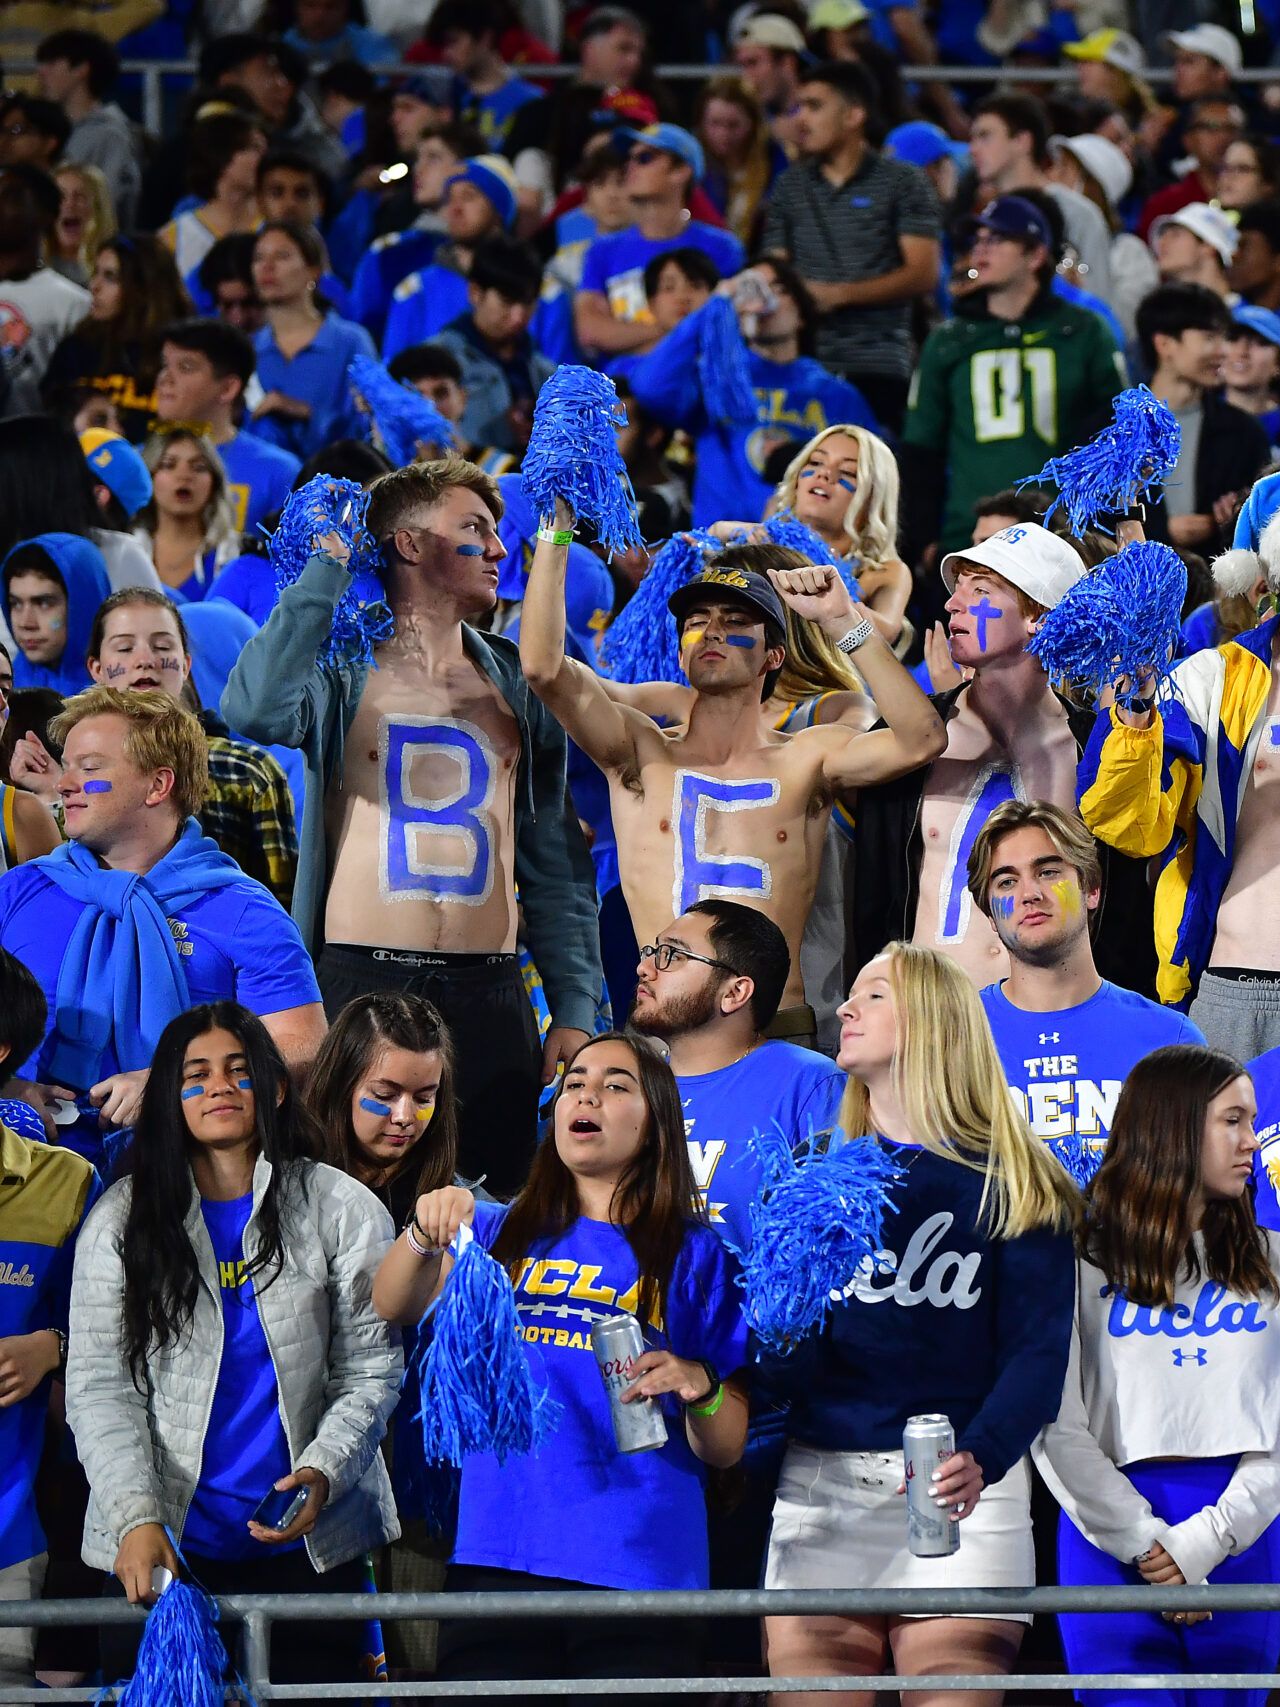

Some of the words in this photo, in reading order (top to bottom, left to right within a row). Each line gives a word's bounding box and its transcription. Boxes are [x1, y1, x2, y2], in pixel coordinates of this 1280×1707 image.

[378, 714, 497, 905] B
[373, 949, 447, 968] Champion
[1023, 1055, 1078, 1078] THE
[829, 1211, 983, 1310] cla
[514, 1325, 594, 1351] OTBAL
